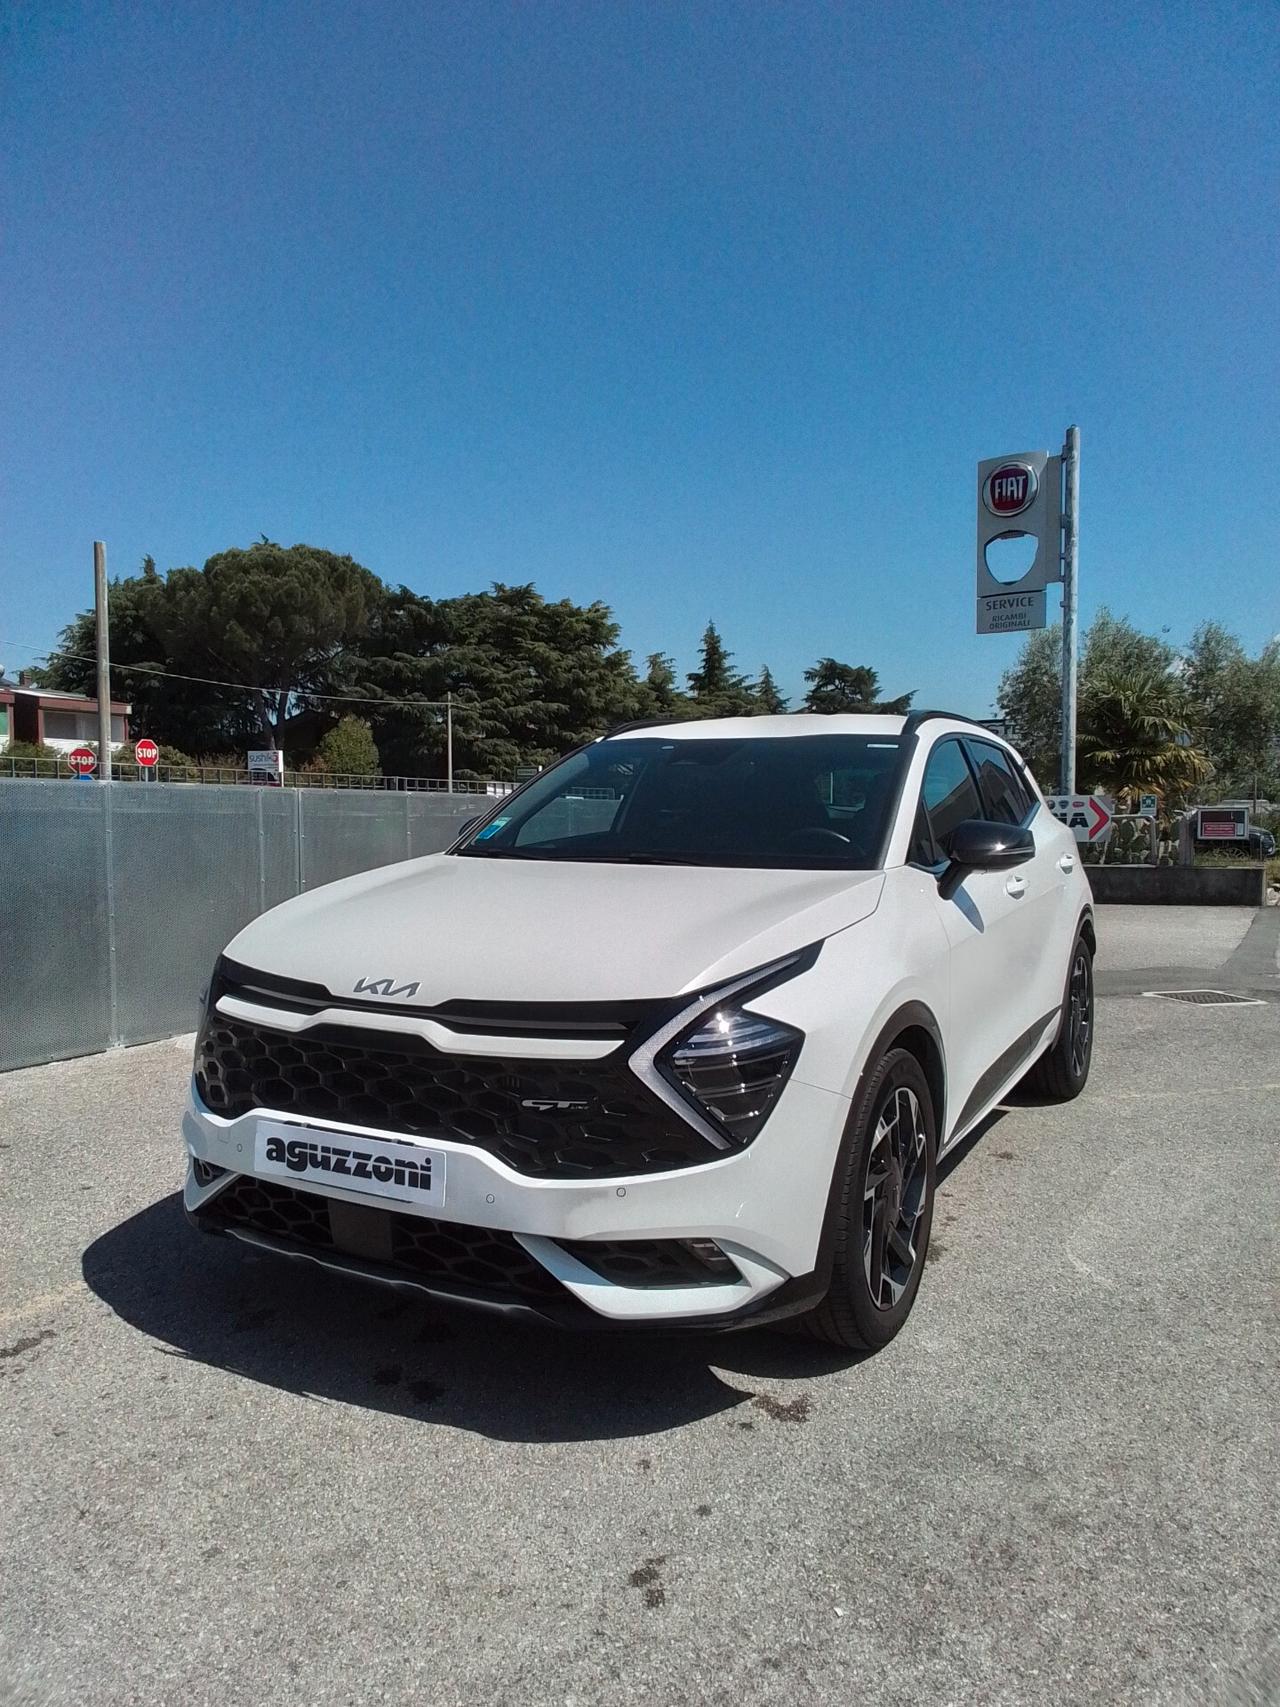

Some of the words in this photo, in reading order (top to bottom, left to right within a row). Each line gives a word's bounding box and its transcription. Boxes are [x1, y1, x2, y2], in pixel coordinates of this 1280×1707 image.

[994, 475, 1026, 501] FIAT
[985, 596, 1034, 611] SERVICE
[992, 612, 1026, 622] RICAMBI
[989, 620, 1030, 630] ORIGINALI
[137, 748, 157, 758] STOP
[70, 756, 94, 765] STOP
[266, 1137, 432, 1191] aguzzoni
